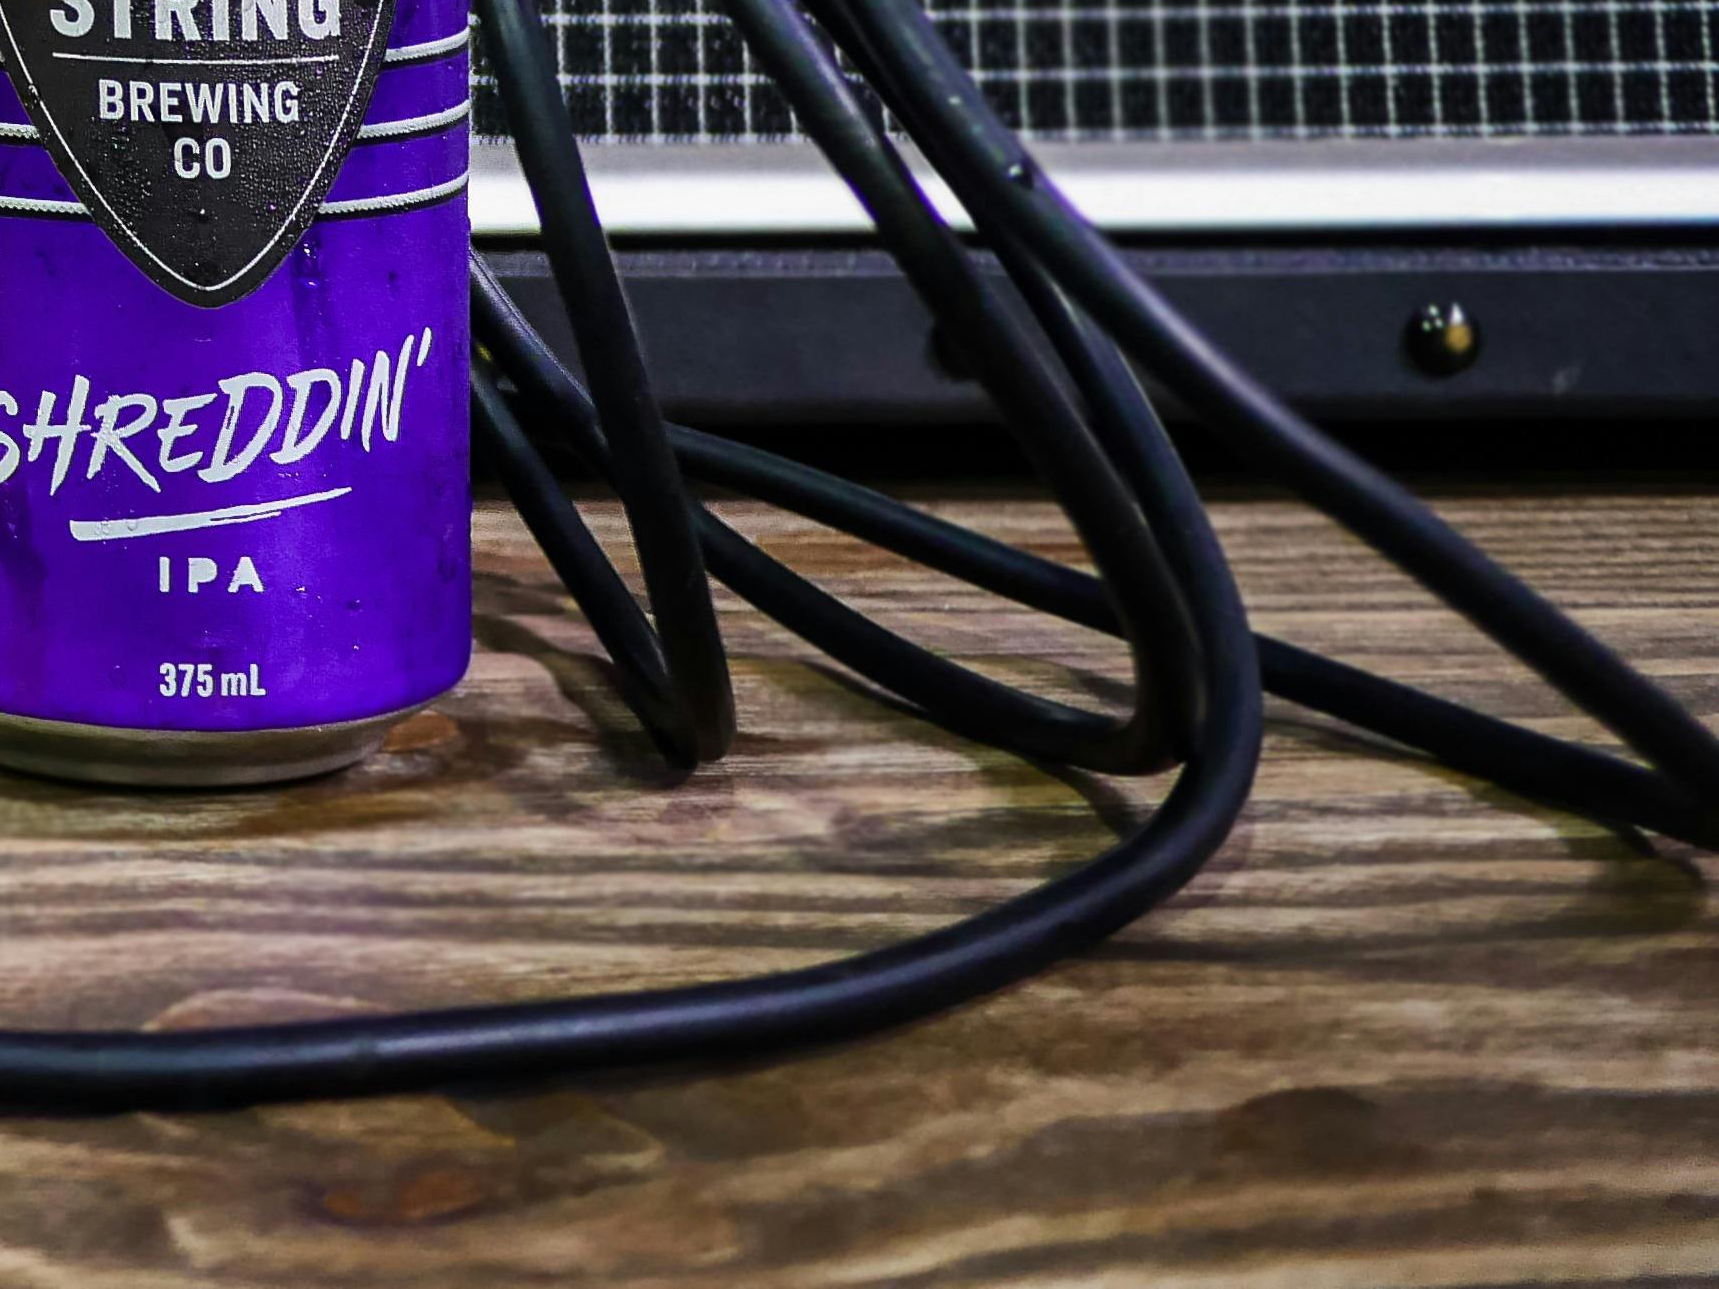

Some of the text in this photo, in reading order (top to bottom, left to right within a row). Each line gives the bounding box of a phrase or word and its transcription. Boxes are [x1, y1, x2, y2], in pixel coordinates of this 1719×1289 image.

[98, 77, 299, 123] BREWING
[173, 138, 232, 180] CO
[159, 557, 264, 594] IPA
